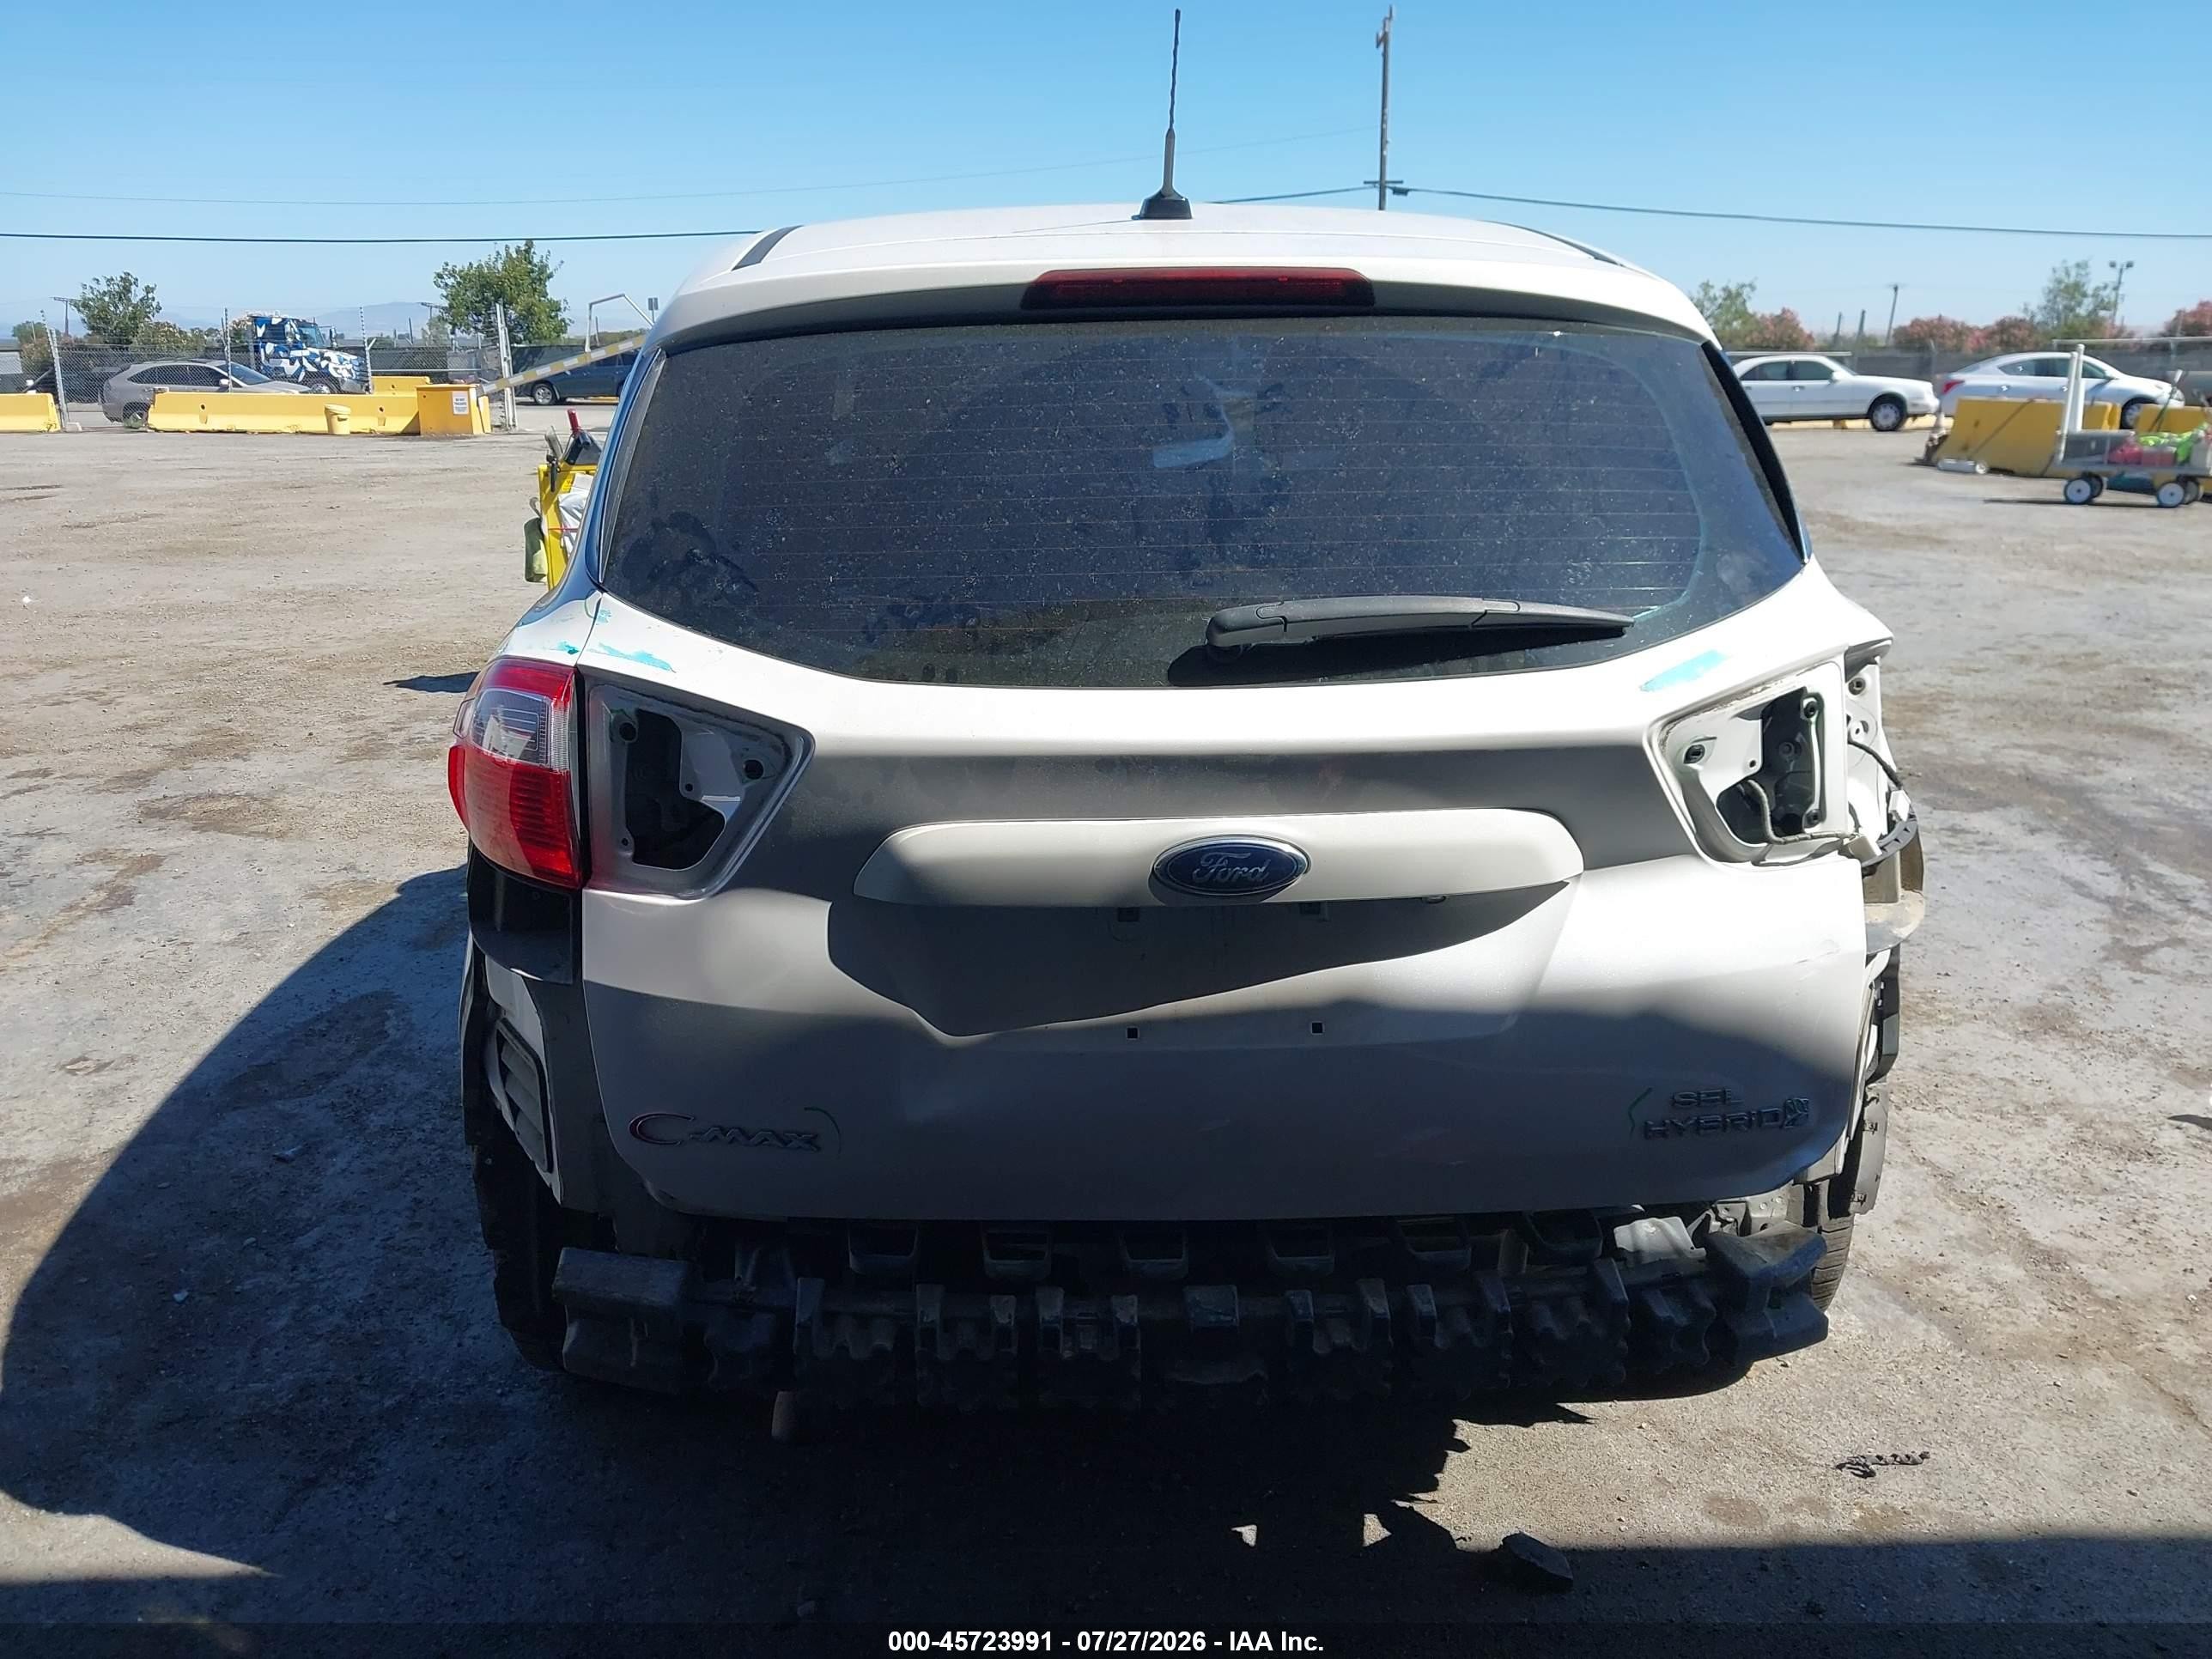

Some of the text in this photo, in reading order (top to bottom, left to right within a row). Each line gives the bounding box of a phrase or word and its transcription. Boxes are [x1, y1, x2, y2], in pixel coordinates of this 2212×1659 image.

[1192, 853, 1272, 883] Ford
[1672, 1089, 1744, 1107] SEL
[1644, 1108, 1784, 1139] HYBRID
